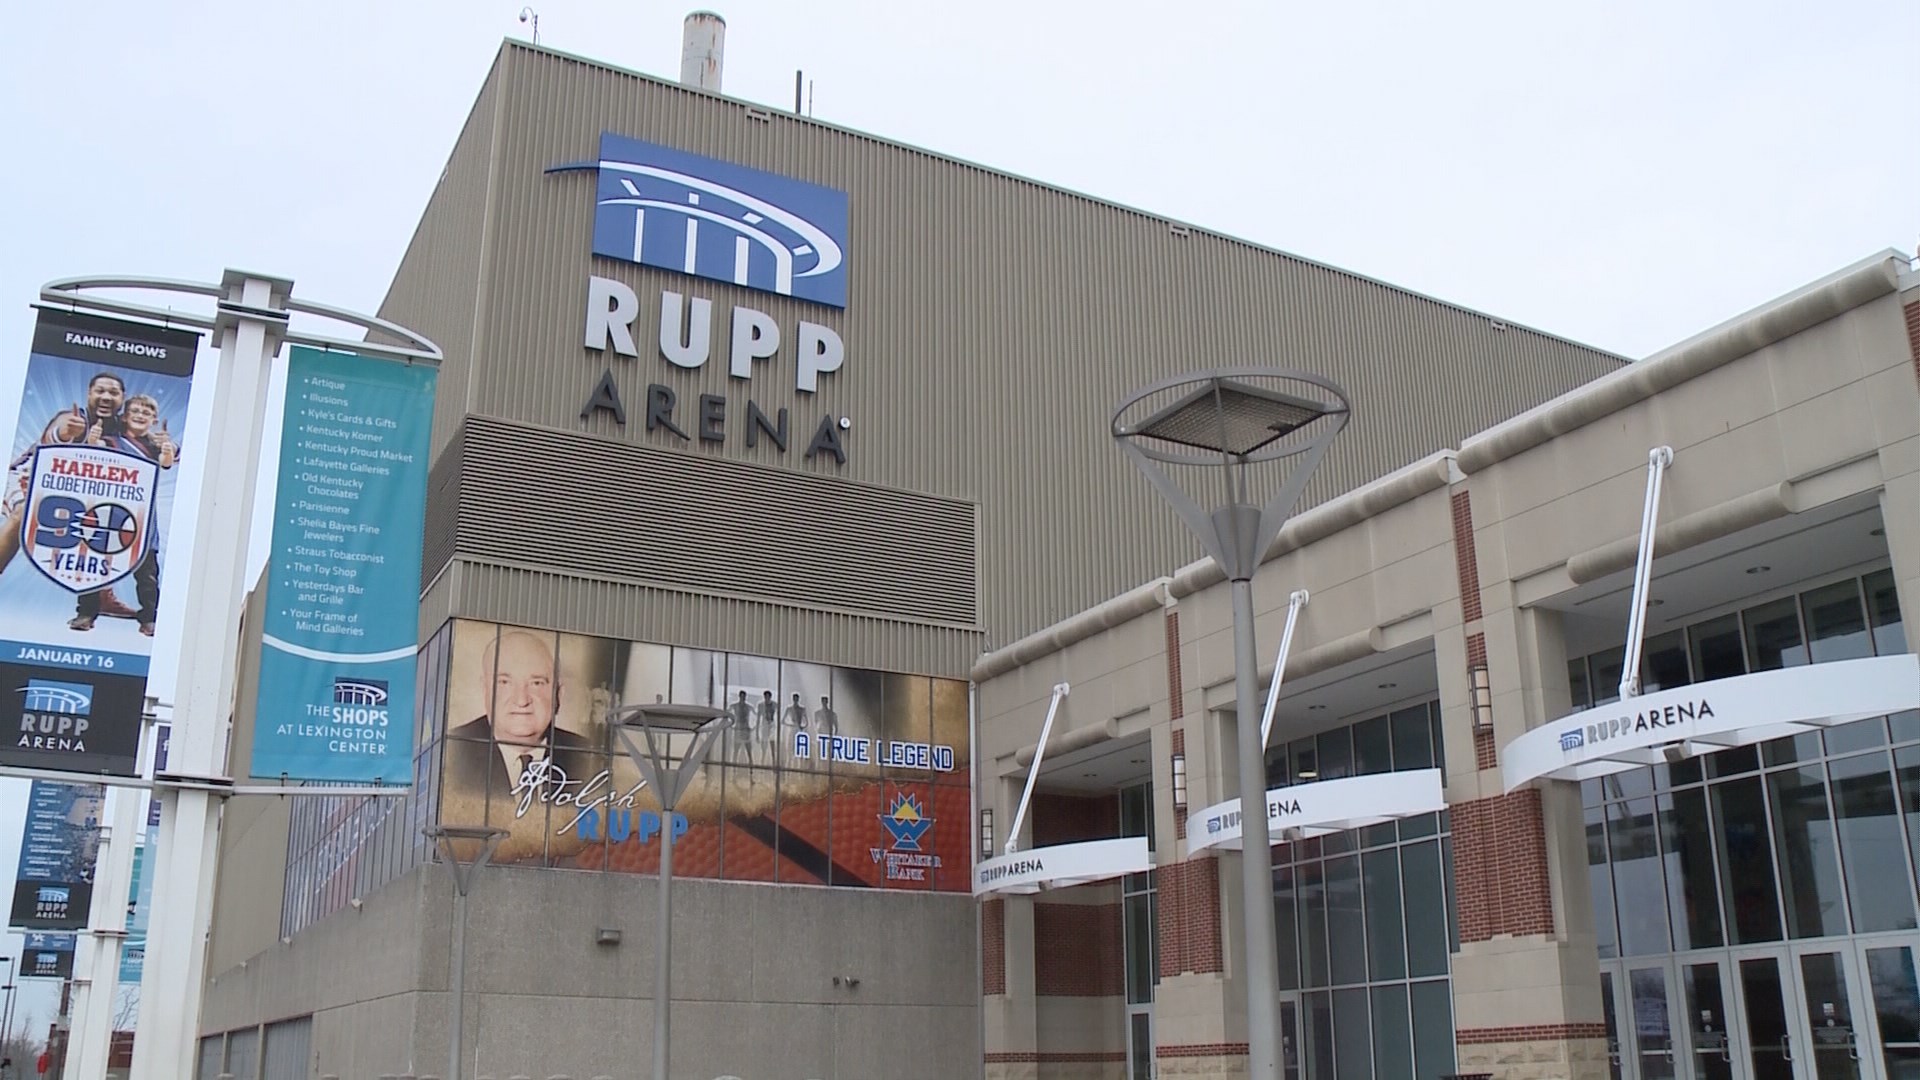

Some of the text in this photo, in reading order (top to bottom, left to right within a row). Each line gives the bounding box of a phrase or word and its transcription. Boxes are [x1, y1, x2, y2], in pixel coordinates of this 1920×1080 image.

[584, 274, 845, 393] RUPP
[65, 332, 167, 359] FAMILY SHOWS
[311, 377, 346, 391] Artique
[309, 393, 349, 406] Illusions
[308, 408, 397, 429] Kyle's Cards & Gifts
[580, 367, 846, 464] ARENA
[306, 424, 383, 442] Kentucky Korner
[304, 441, 413, 463] Kentucky Proud Market
[51, 457, 140, 485] HARLEM
[303, 457, 390, 476] Lafayette Galleries
[41, 473, 144, 501] GLOBETROTTERS
[301, 472, 364, 489] Old Kentucky
[307, 485, 359, 499] Chocolates
[299, 500, 350, 515] Parisienne
[303, 530, 344, 543] Jewelers
[329, 520, 357, 535] Bayes
[359, 524, 380, 535] Fine
[295, 545, 385, 564] Straus Tobacconist
[53, 553, 110, 576] YEARS
[293, 562, 357, 578] The Toy Shop
[292, 579, 364, 595] Yesterdays Bar
[298, 592, 344, 605] and Grille
[290, 608, 358, 623] Your Frame of
[295, 621, 364, 636] Mind Galleries
[17, 647, 114, 668] JANUARY 16
[20, 713, 90, 736] RUPP
[305, 704, 388, 727] THE SHOPS
[1586, 699, 1714, 744] RUPP ARENA
[277, 723, 386, 740] AT LEXINGTON
[18, 734, 86, 752] ARENA
[328, 740, 387, 755] CENTER
[795, 732, 955, 772] A TRUE LEGEND
[1268, 799, 1302, 818] ENA
[576, 808, 689, 845] RUPP
[1008, 859, 1043, 877] ARENA
[35, 911, 67, 919] ARENA
[36, 902, 68, 913] RUPP
